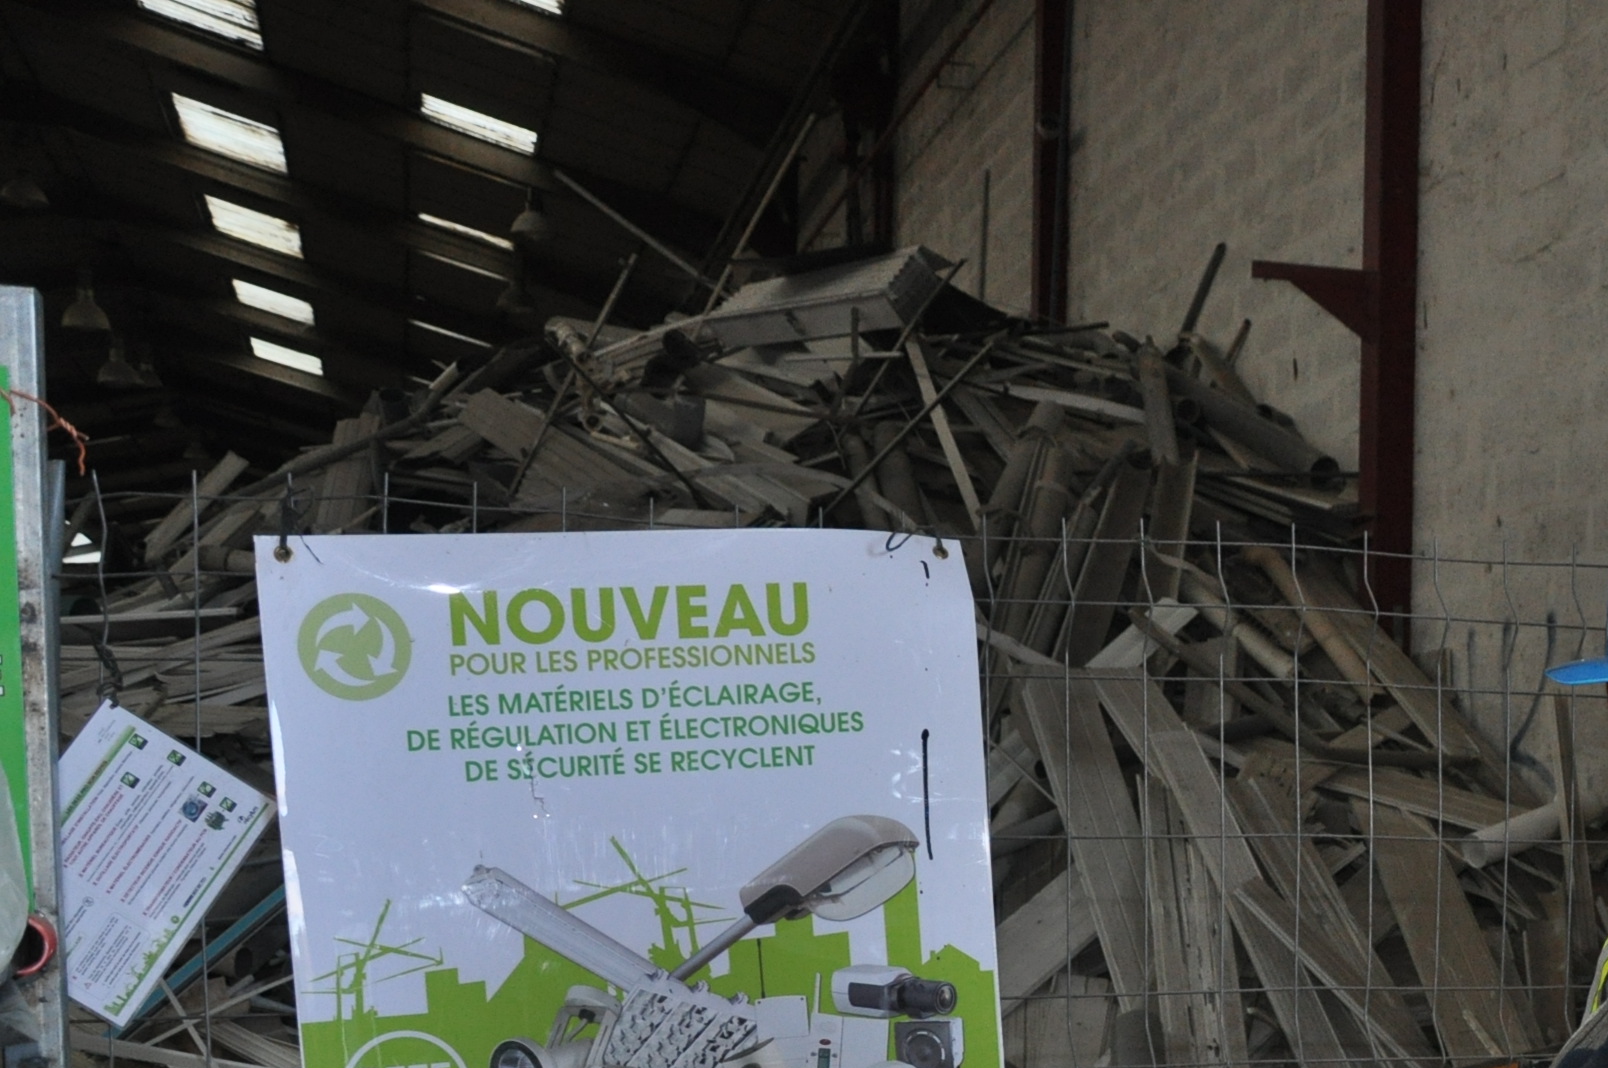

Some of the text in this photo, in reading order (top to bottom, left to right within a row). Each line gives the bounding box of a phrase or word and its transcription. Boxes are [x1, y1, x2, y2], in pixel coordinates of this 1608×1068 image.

[448, 582, 810, 647] NOUVEAU
[449, 641, 816, 677] POUR LES PROFESSIONNELS
[448, 695, 490, 718] LES
[499, 684, 634, 716] MATÉRIELS
[406, 710, 865, 752] DE RÉGULATION ET ÉLECTRONIQUES
[465, 744, 816, 783] DE SÉCURITÉ SE RECYCLENT
